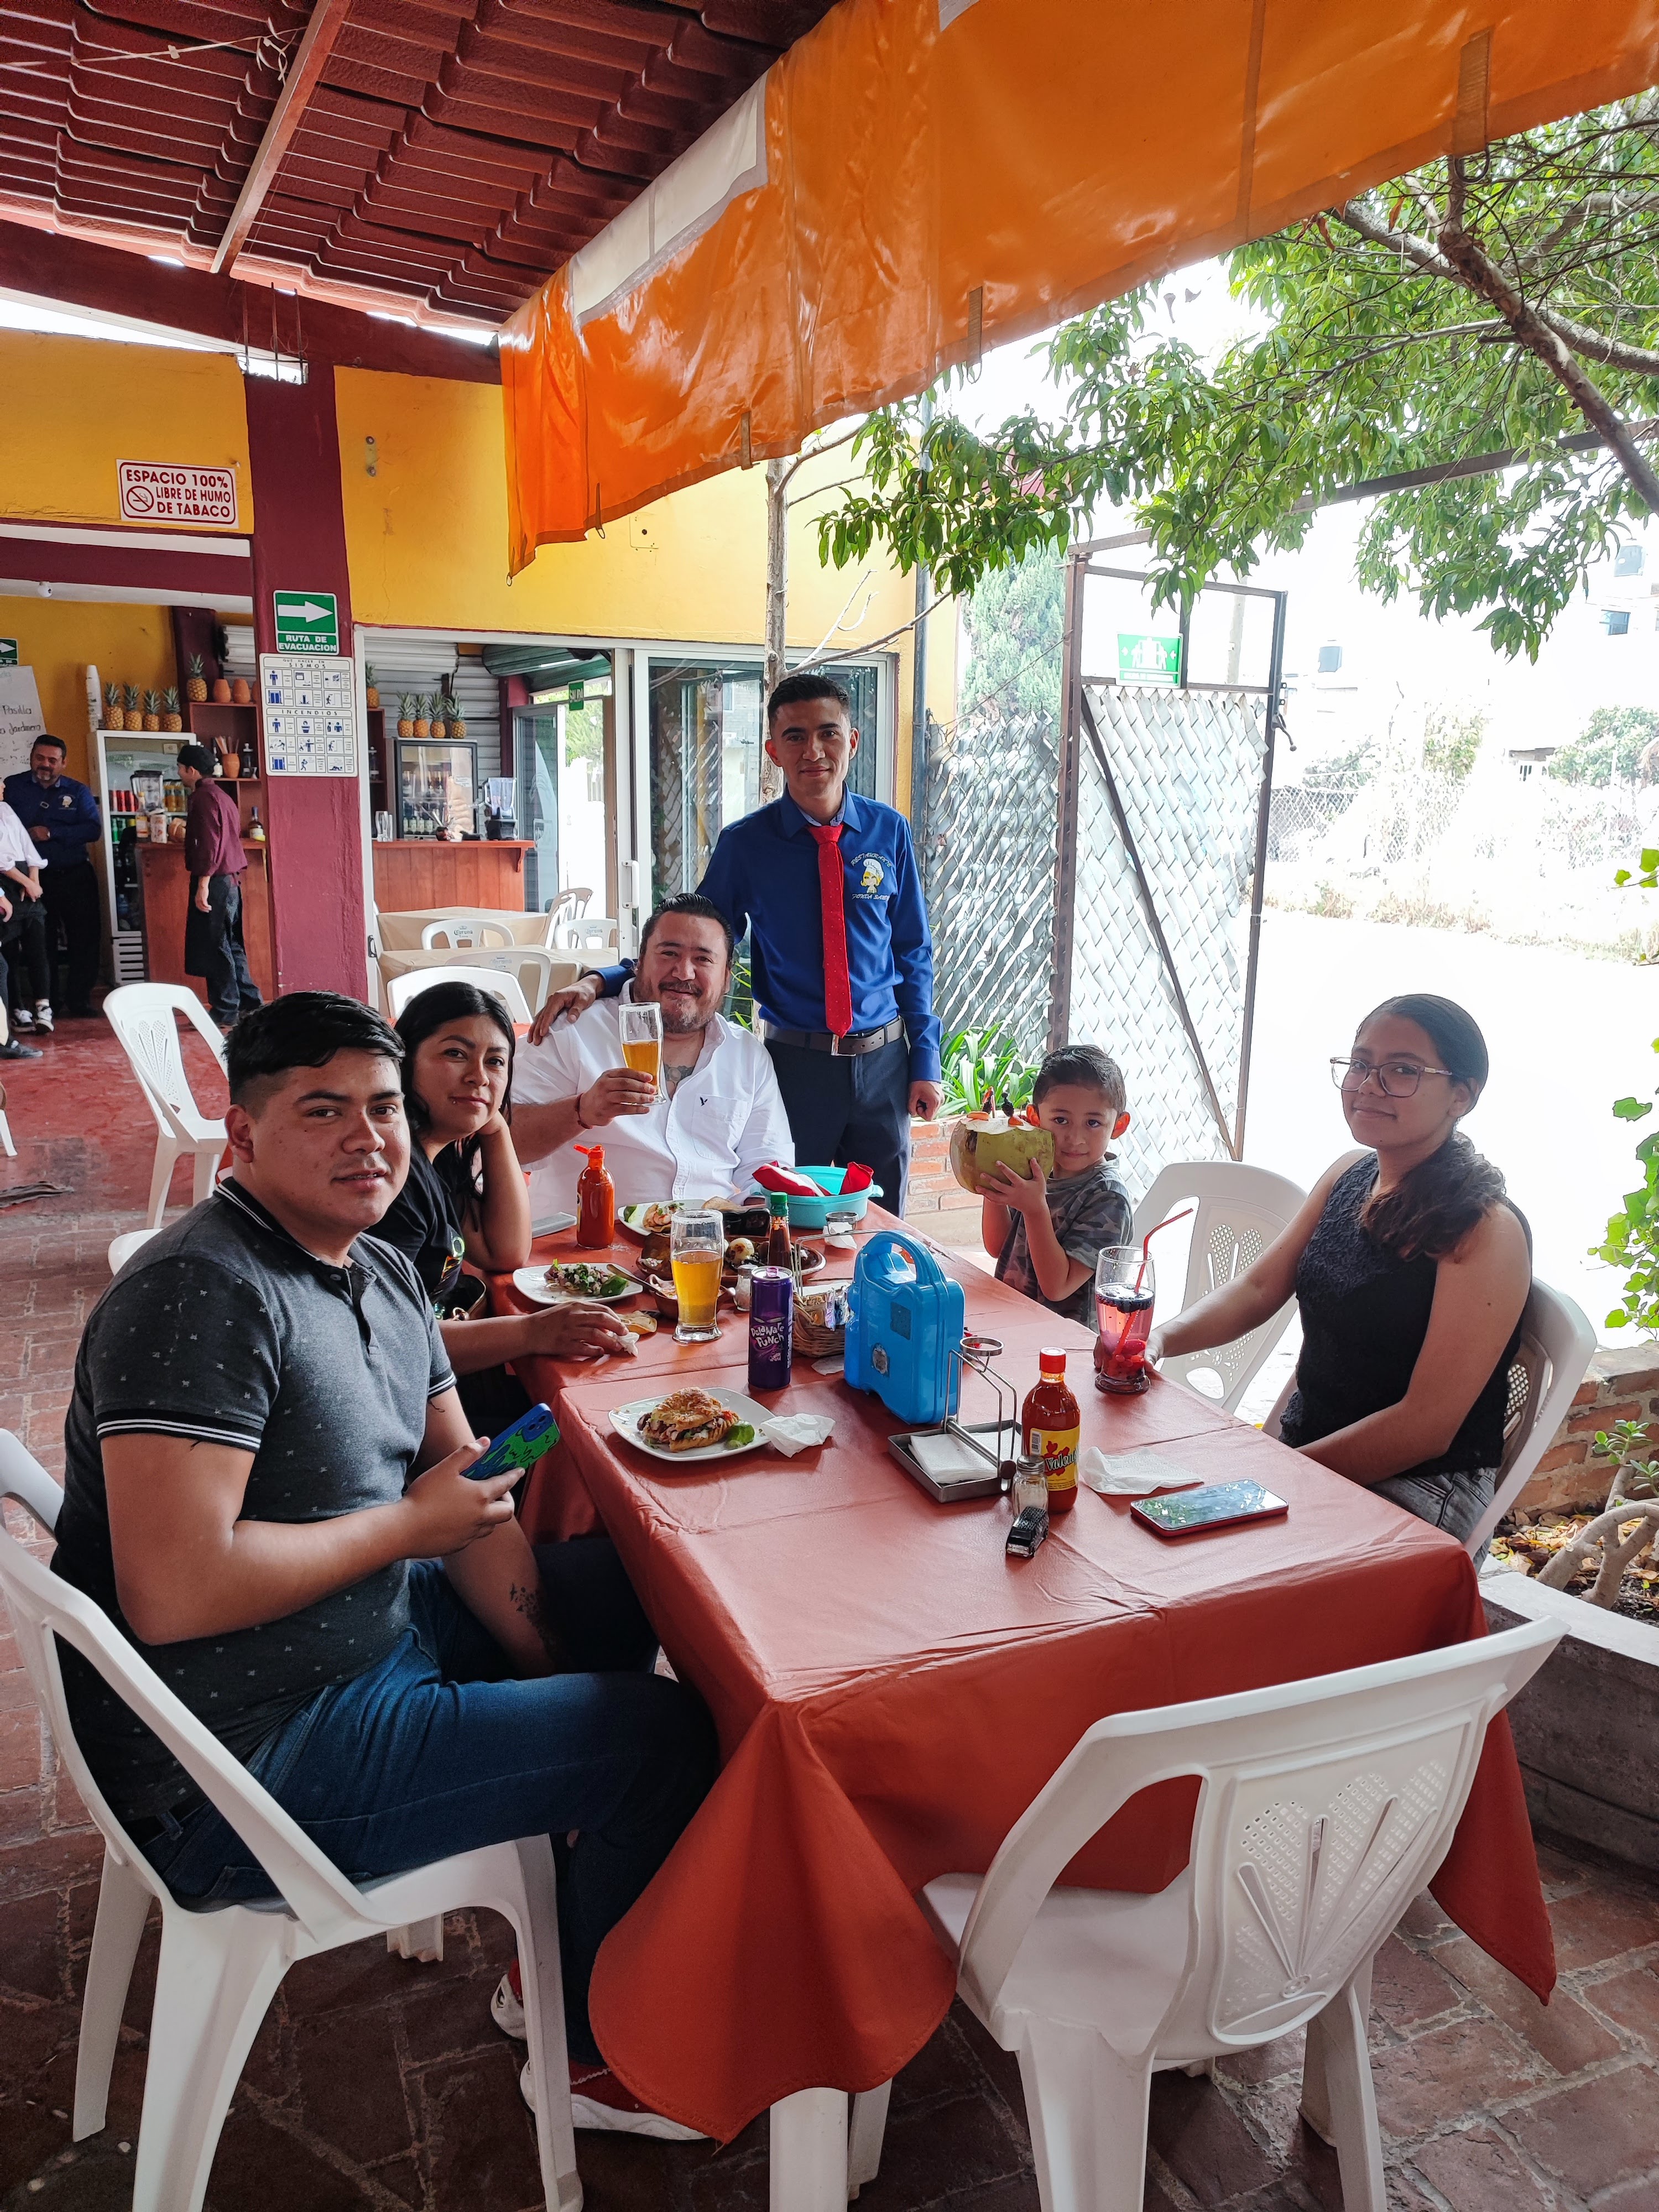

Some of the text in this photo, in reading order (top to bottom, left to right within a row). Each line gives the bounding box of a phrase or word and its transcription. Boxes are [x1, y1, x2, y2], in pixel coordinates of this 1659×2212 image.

[126, 469, 228, 488] ESPACIO 100%
[156, 487, 231, 503] LIBRE DE HUMO
[157, 502, 230, 518] DE TABACO
[279, 643, 337, 651] EVACUACION
